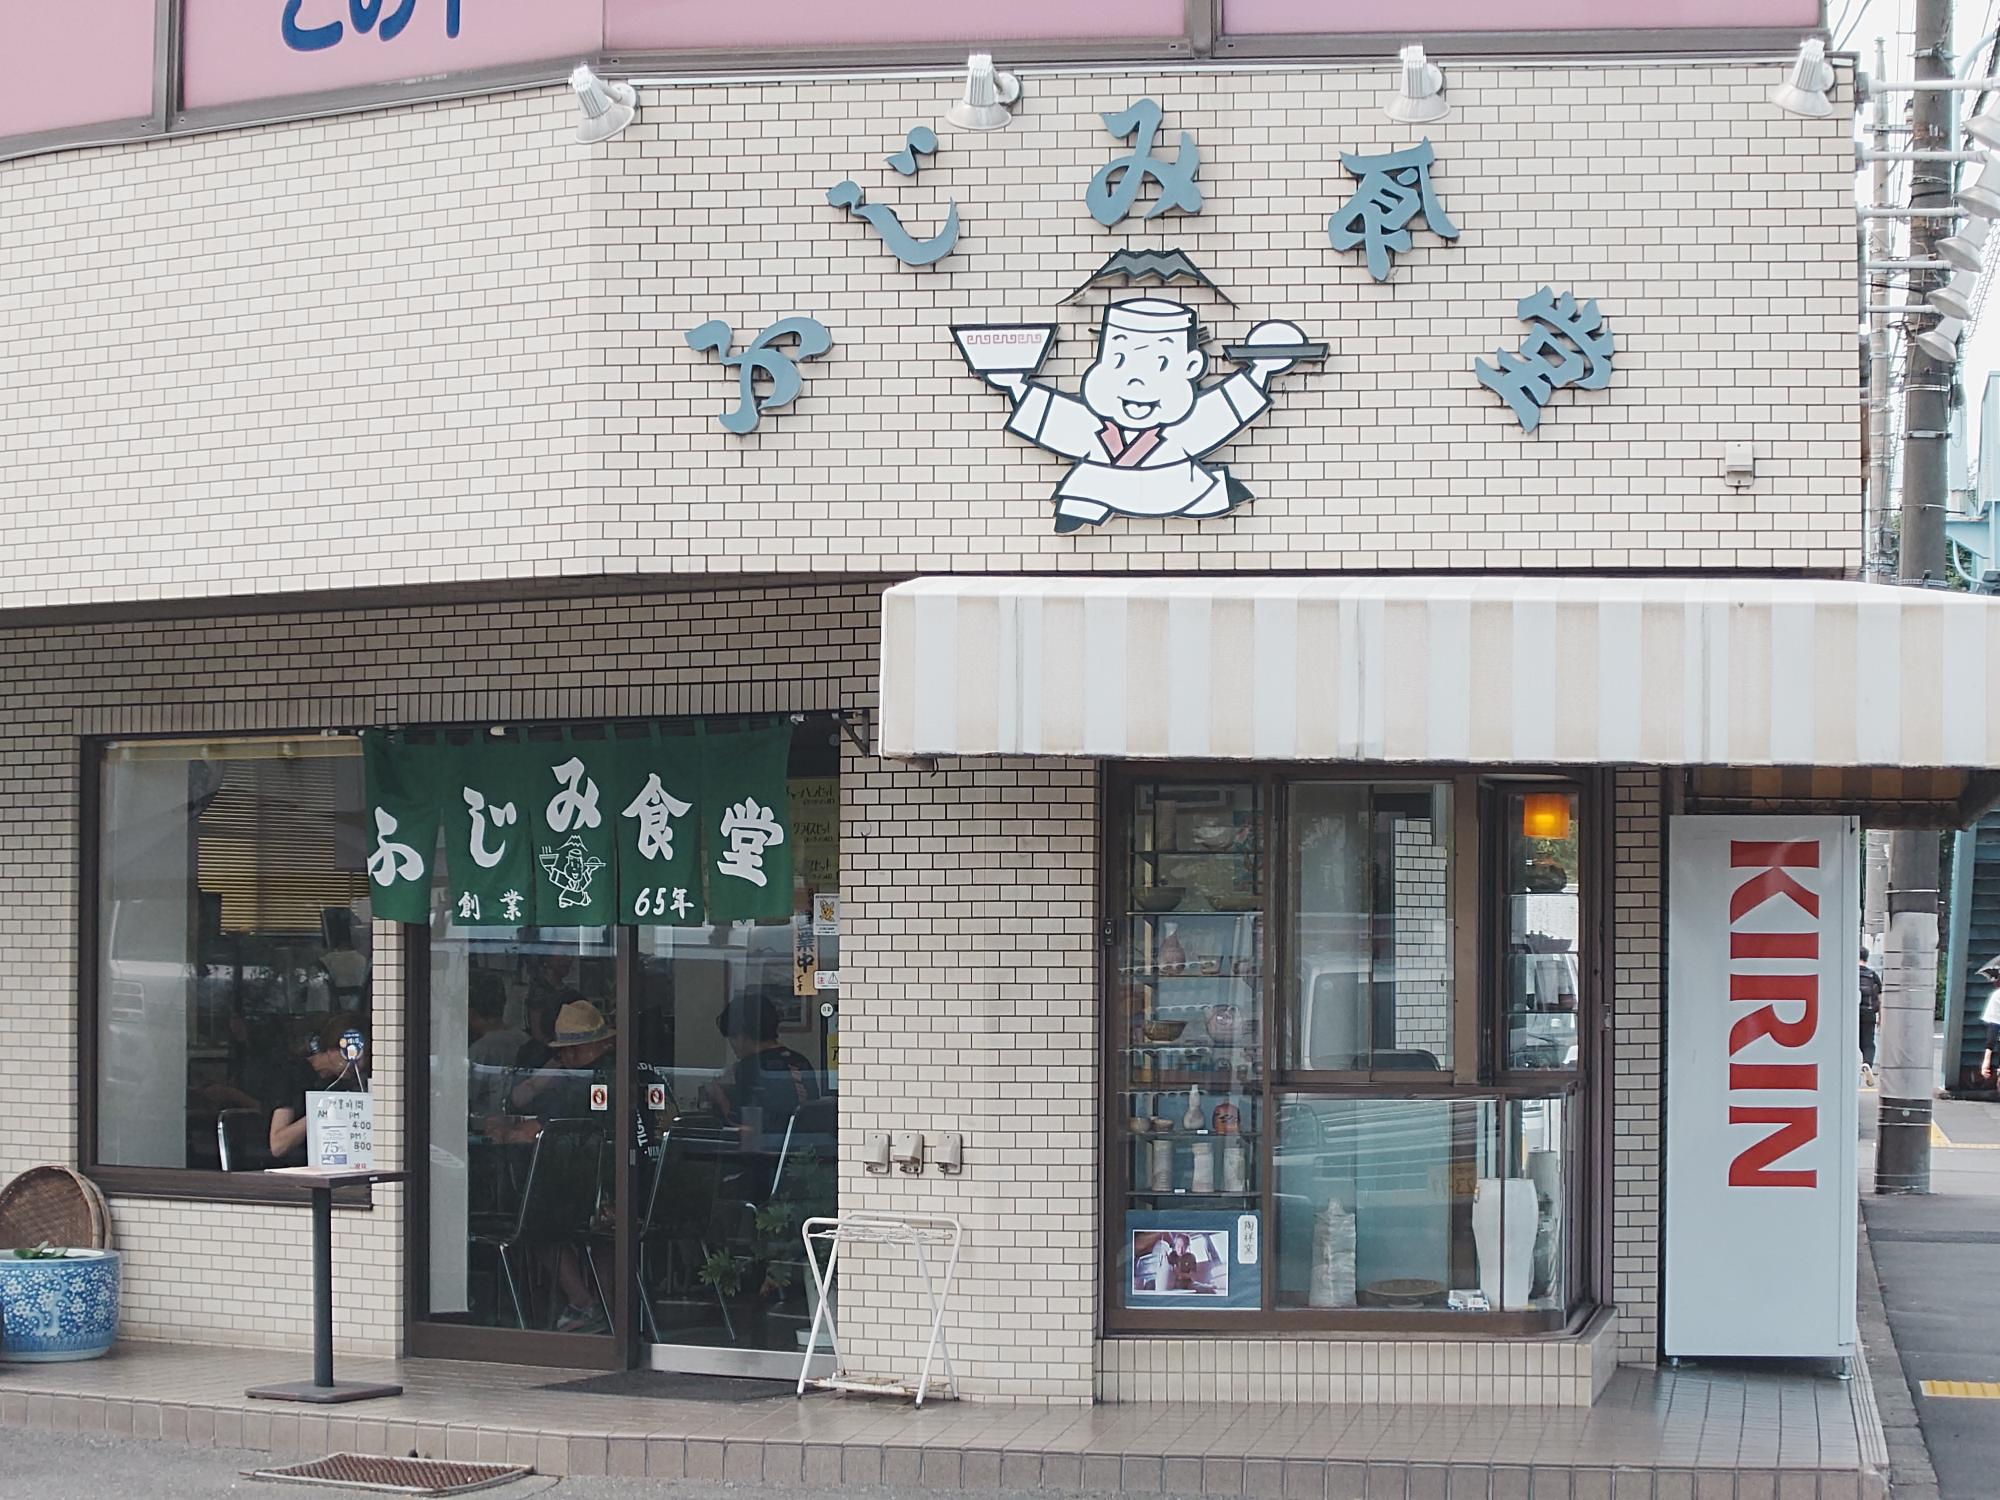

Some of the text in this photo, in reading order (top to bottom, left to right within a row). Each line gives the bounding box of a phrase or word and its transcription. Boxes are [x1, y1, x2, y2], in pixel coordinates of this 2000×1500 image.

[366, 756, 785, 888] ふじみ食堂
[457, 887, 696, 920] 創業 65年
[1729, 840, 1820, 1189] KIRIN
